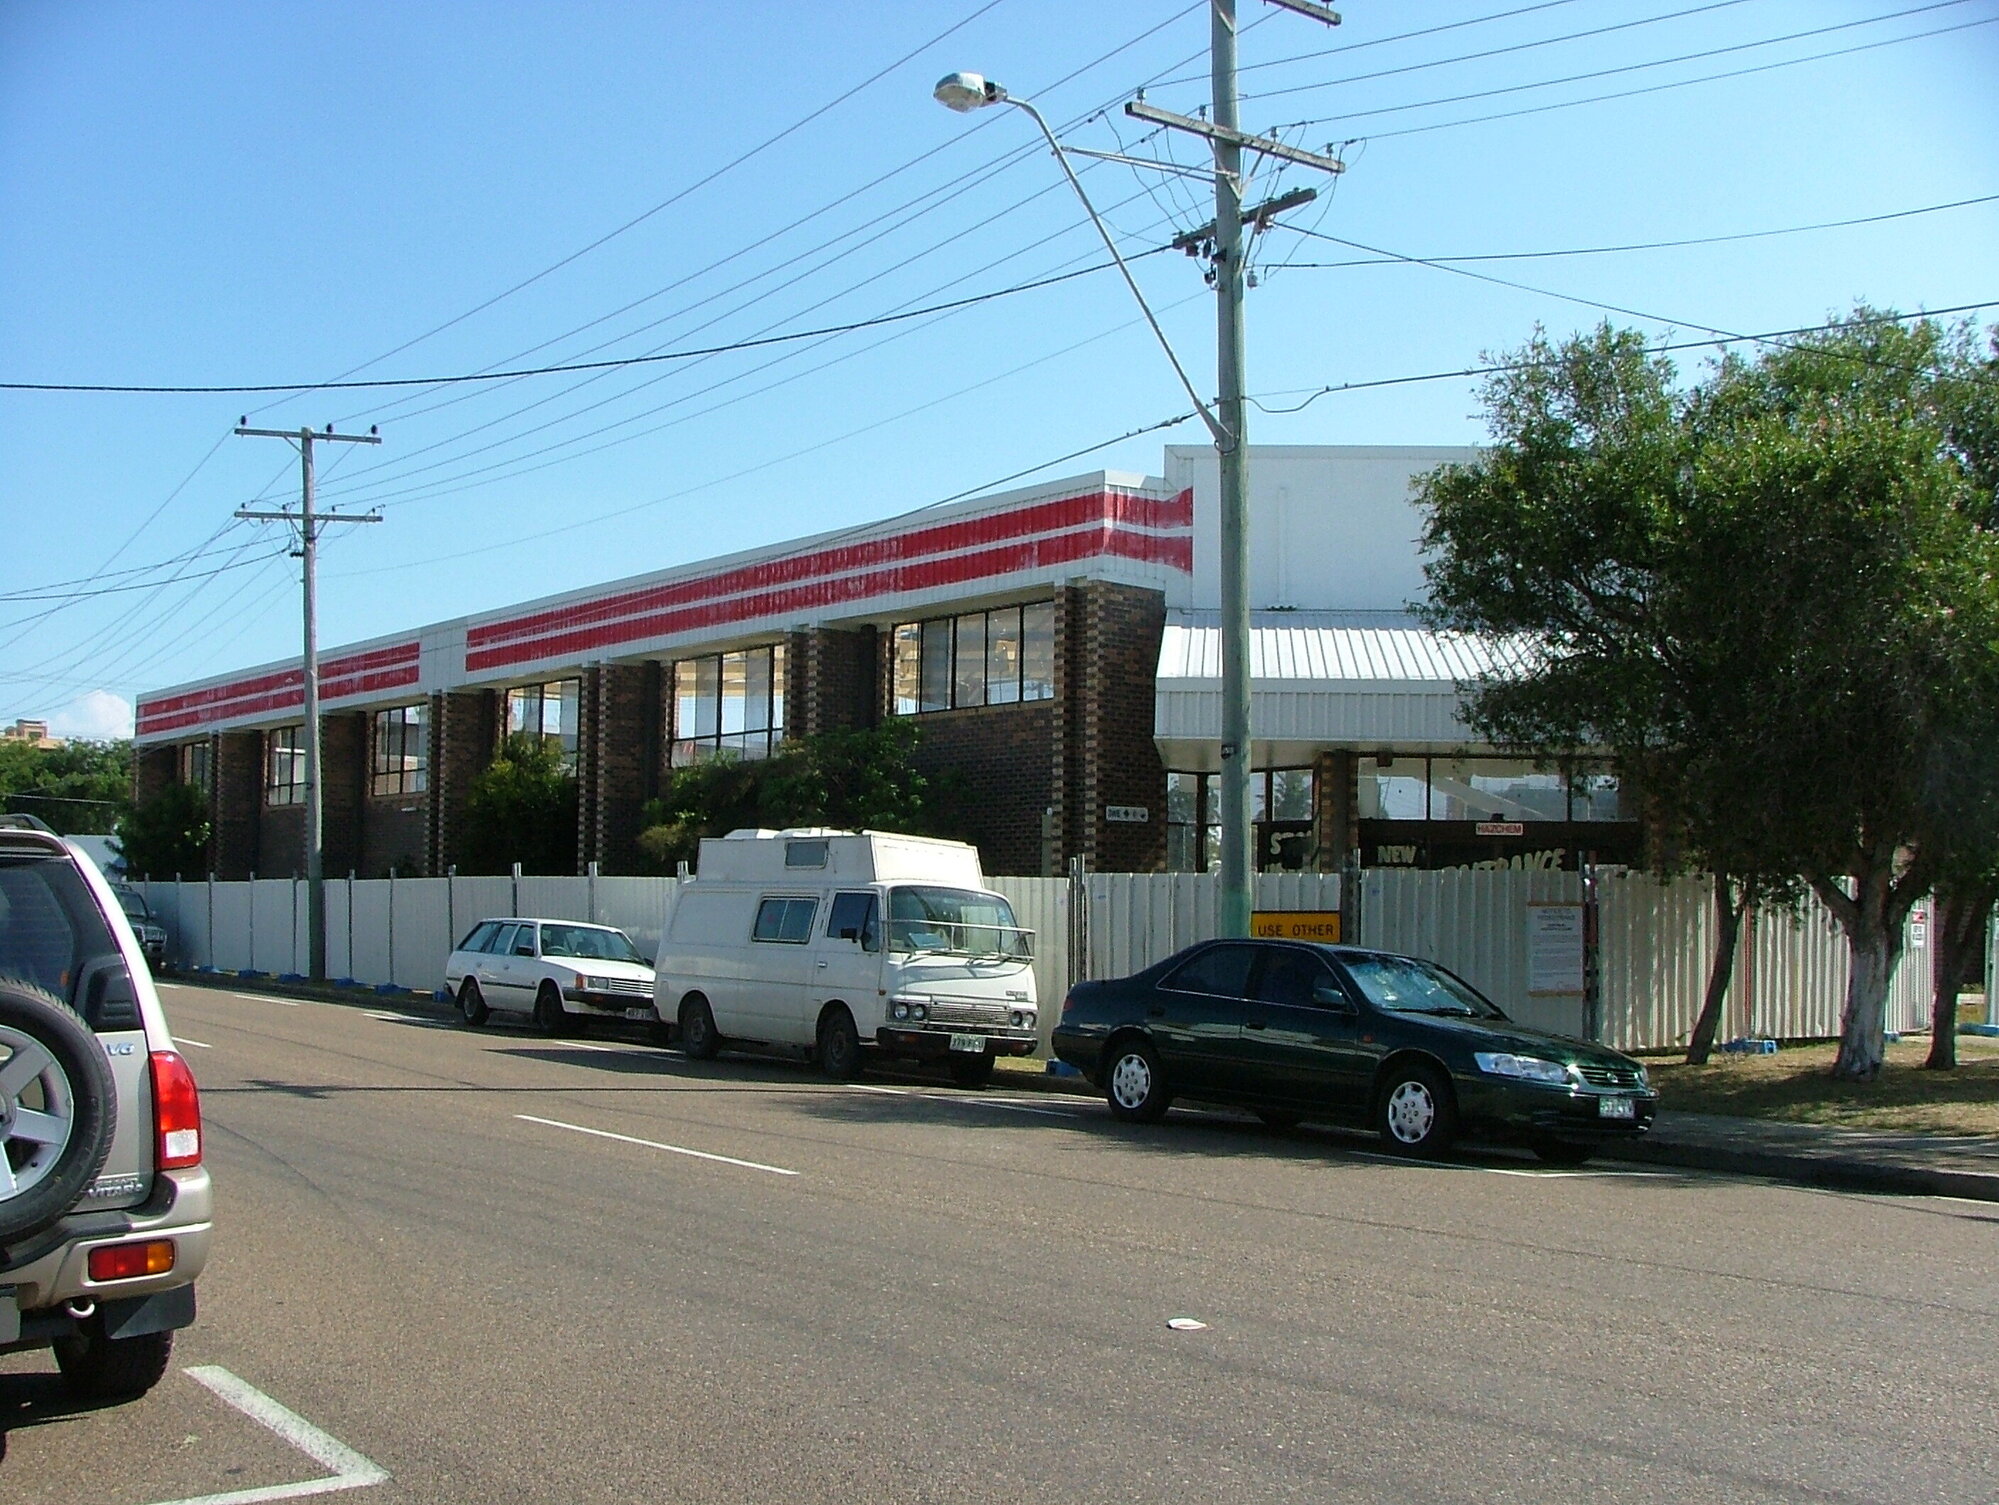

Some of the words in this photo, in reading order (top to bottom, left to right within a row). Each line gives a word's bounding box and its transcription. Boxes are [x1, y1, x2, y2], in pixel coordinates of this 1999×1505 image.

[1377, 845, 1416, 864] NEW
[1441, 848, 1566, 871] RANCE
[1258, 924, 1283, 937] USE
[1292, 923, 1335, 937] OTHER
[106, 1042, 135, 1057] V6
